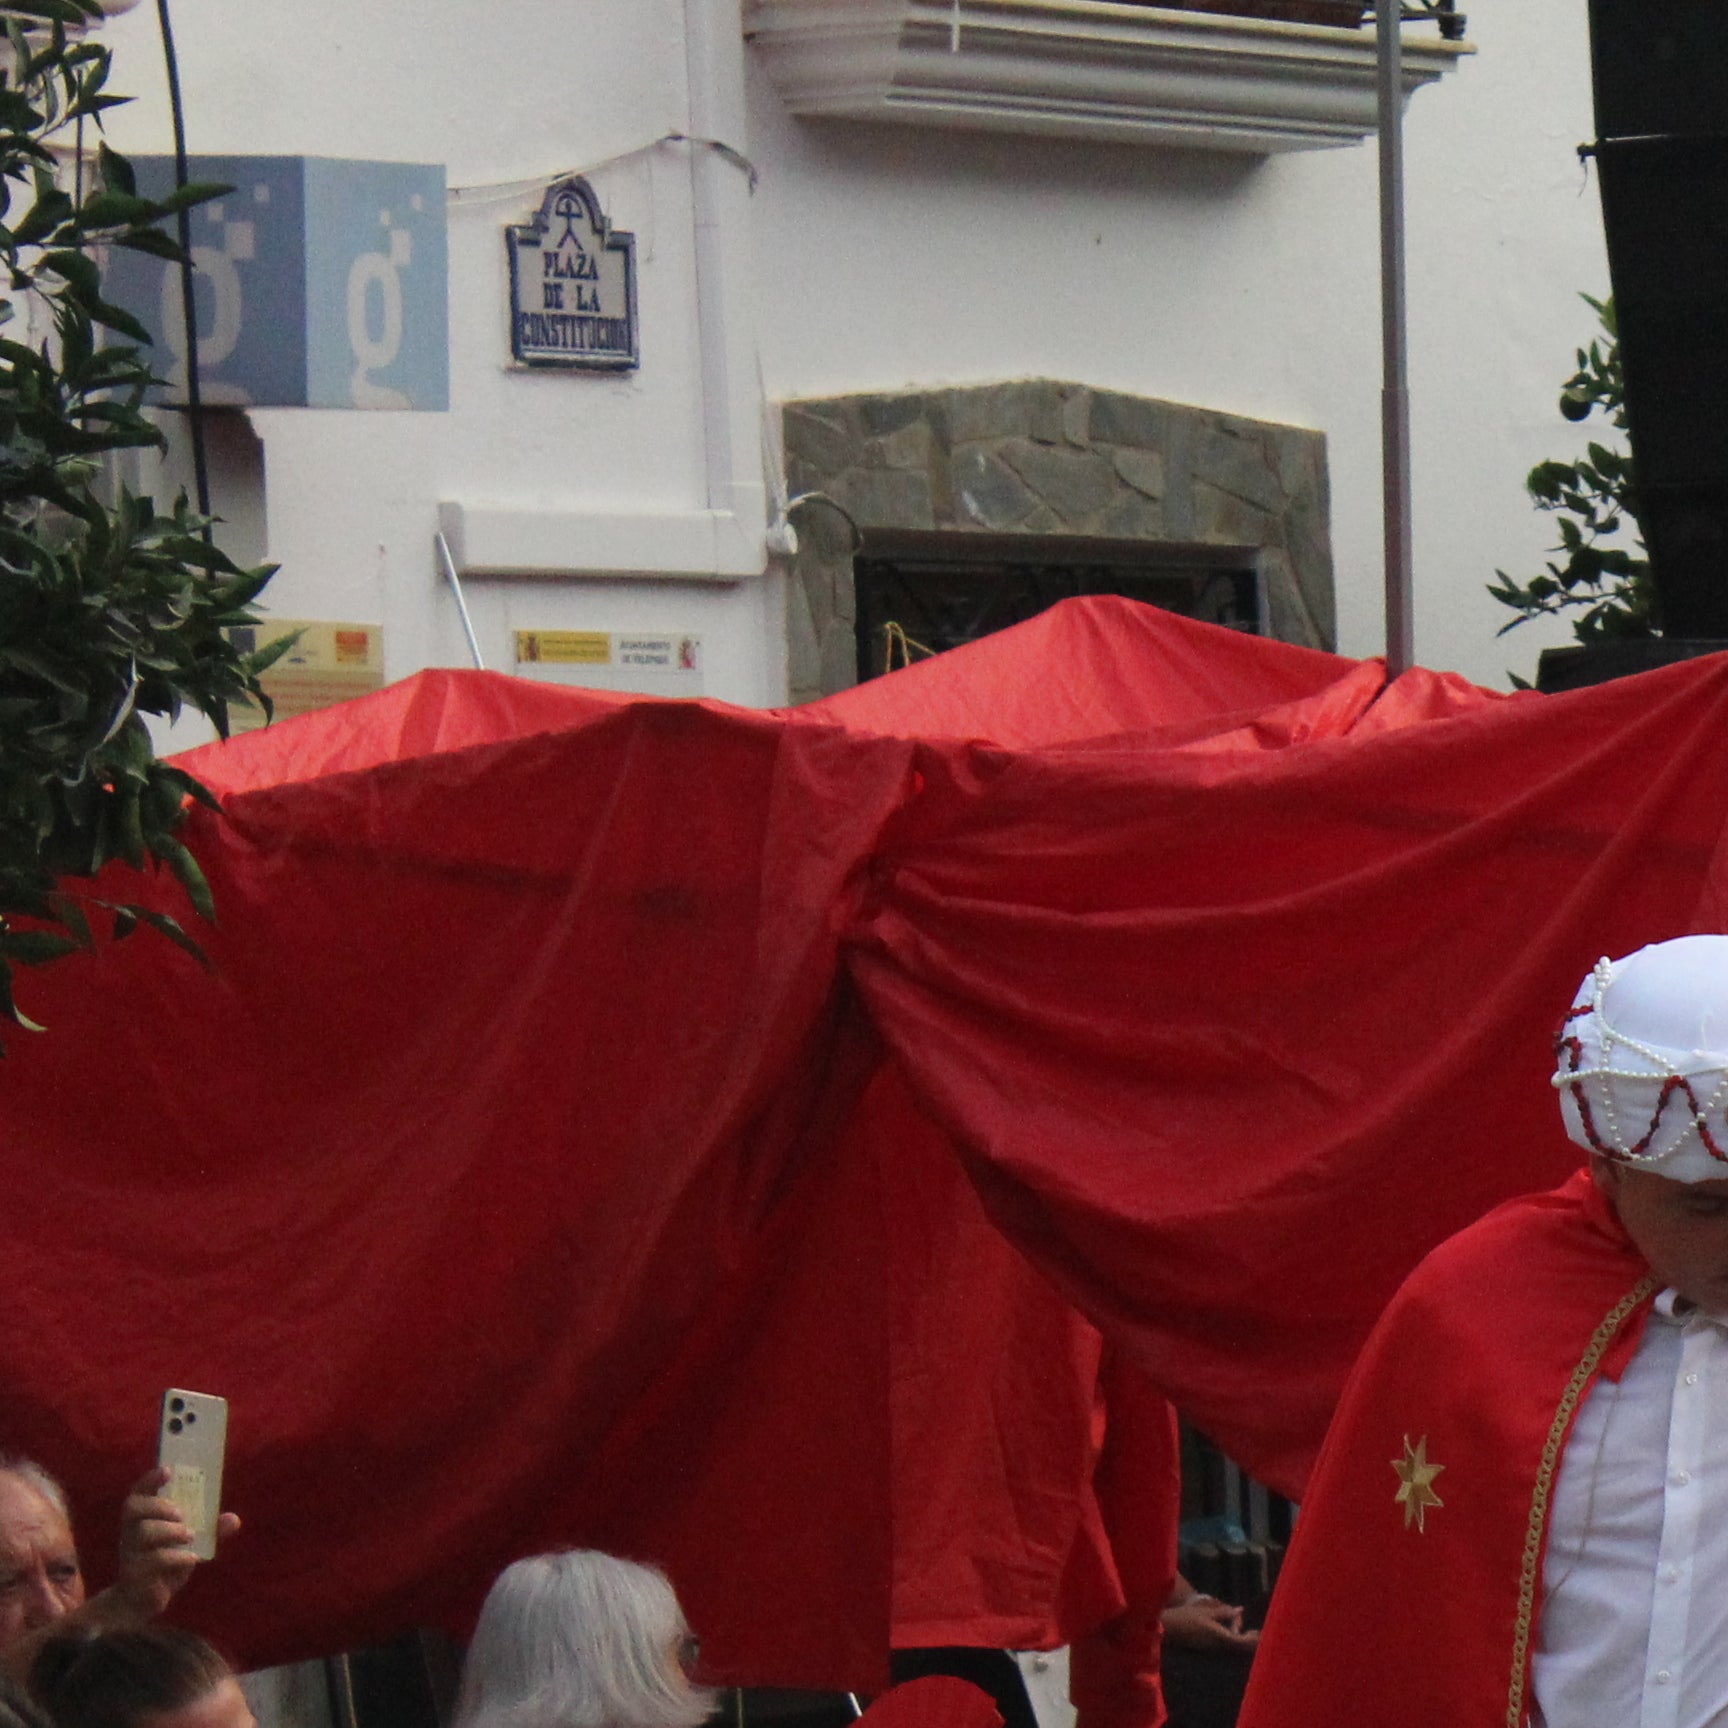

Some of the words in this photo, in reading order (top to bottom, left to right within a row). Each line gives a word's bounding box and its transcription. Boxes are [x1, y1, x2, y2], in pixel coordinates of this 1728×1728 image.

[543, 251, 599, 281] PLAZA
[543, 281, 564, 309] DE
[576, 284, 601, 312] LA
